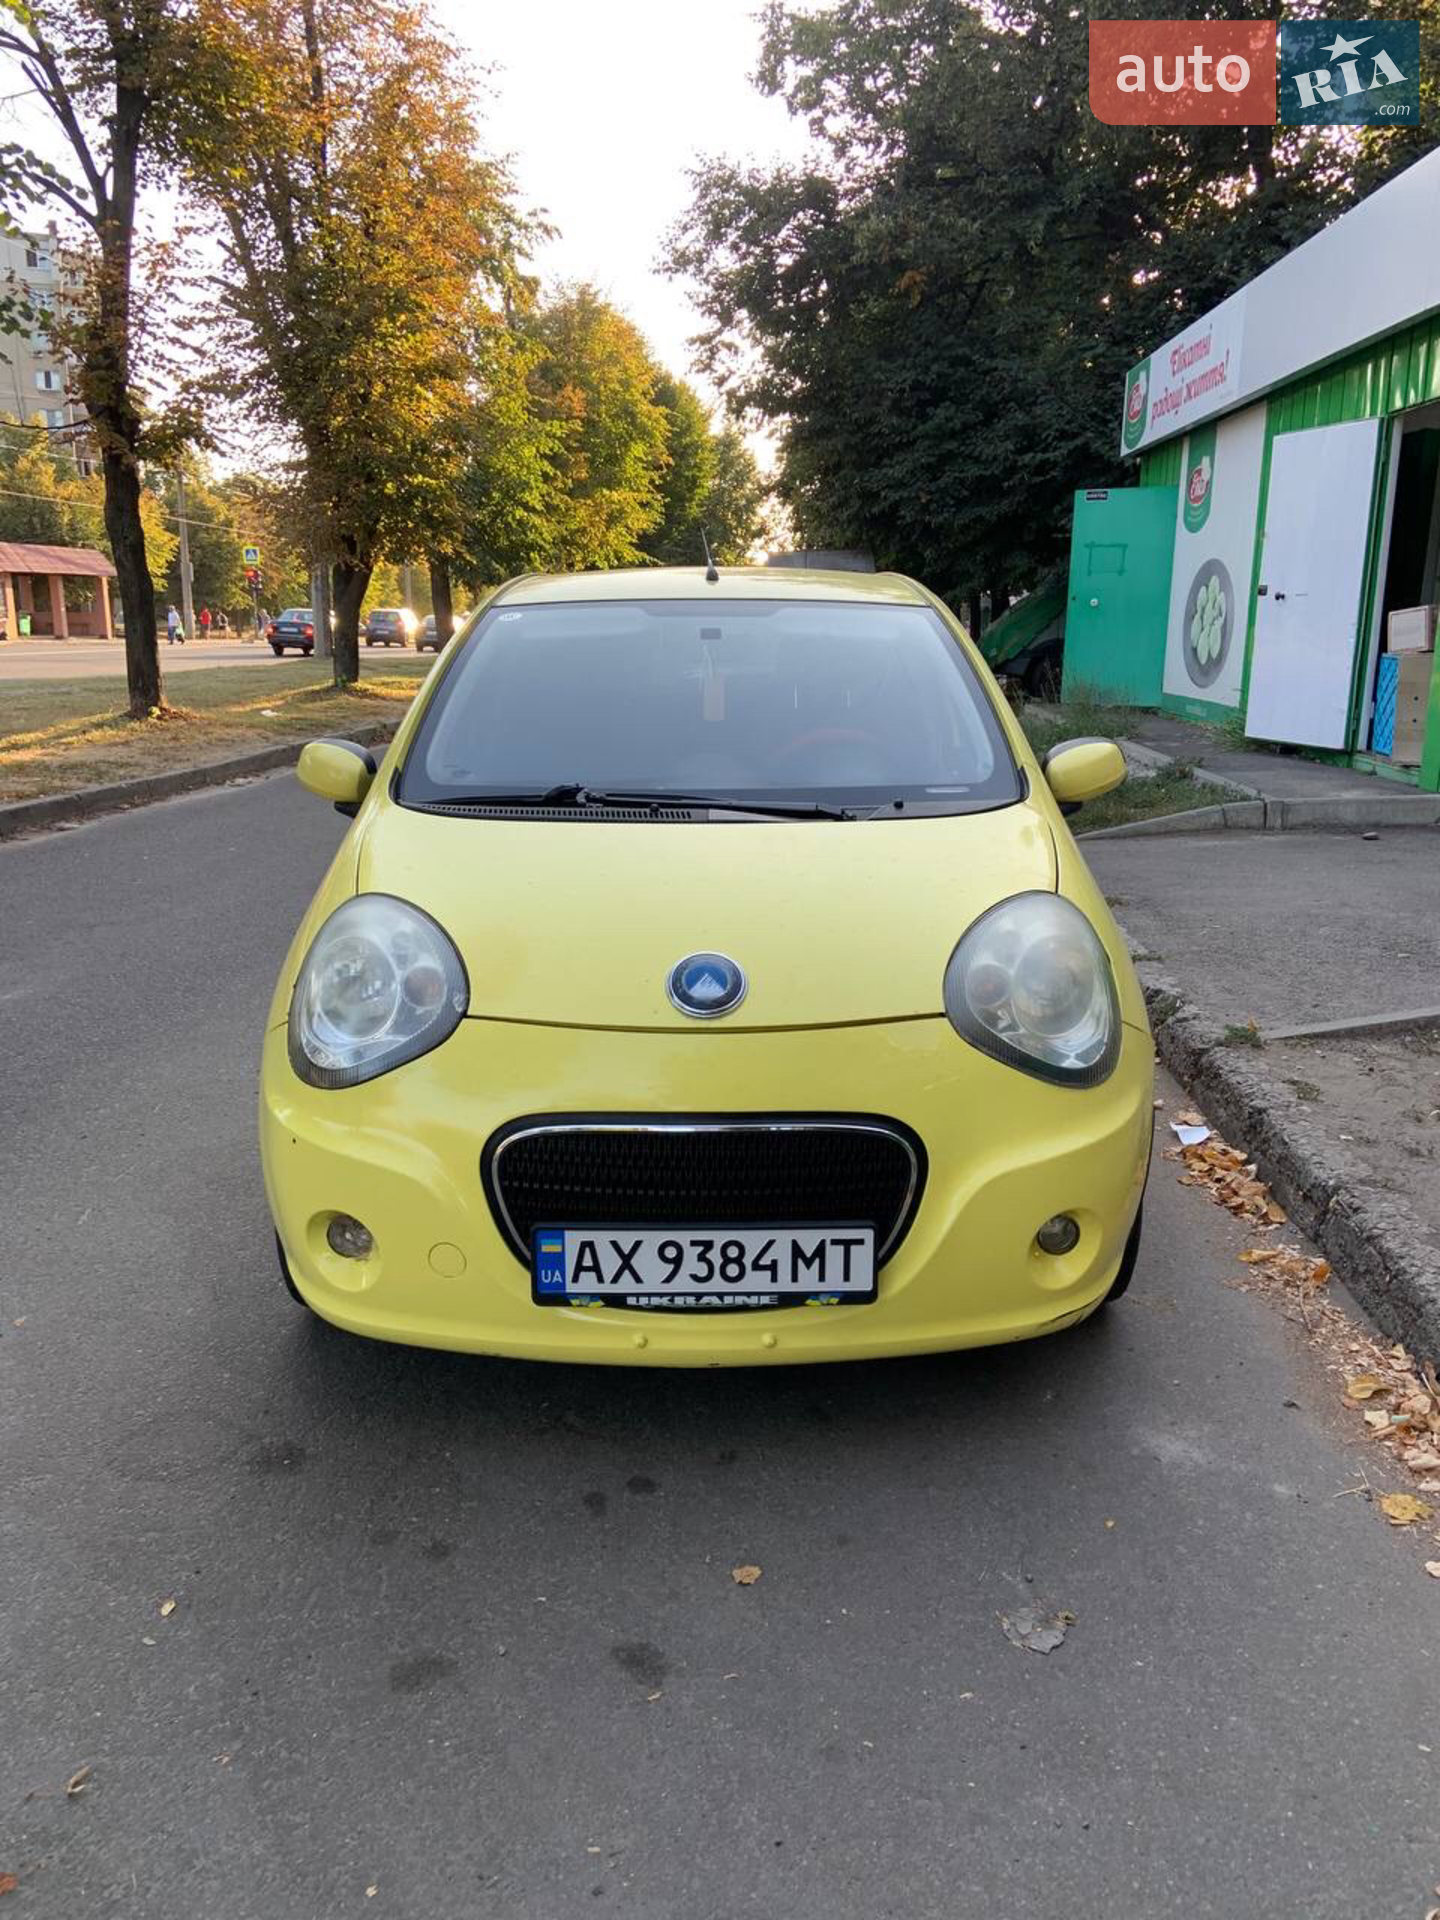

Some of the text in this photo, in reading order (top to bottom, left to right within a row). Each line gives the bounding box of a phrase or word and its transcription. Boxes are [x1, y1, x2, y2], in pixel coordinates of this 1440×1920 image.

[571, 1238, 866, 1285] AX 9384 MT
[541, 1270, 563, 1284] UA
[626, 1295, 779, 1306] UKRAINE
